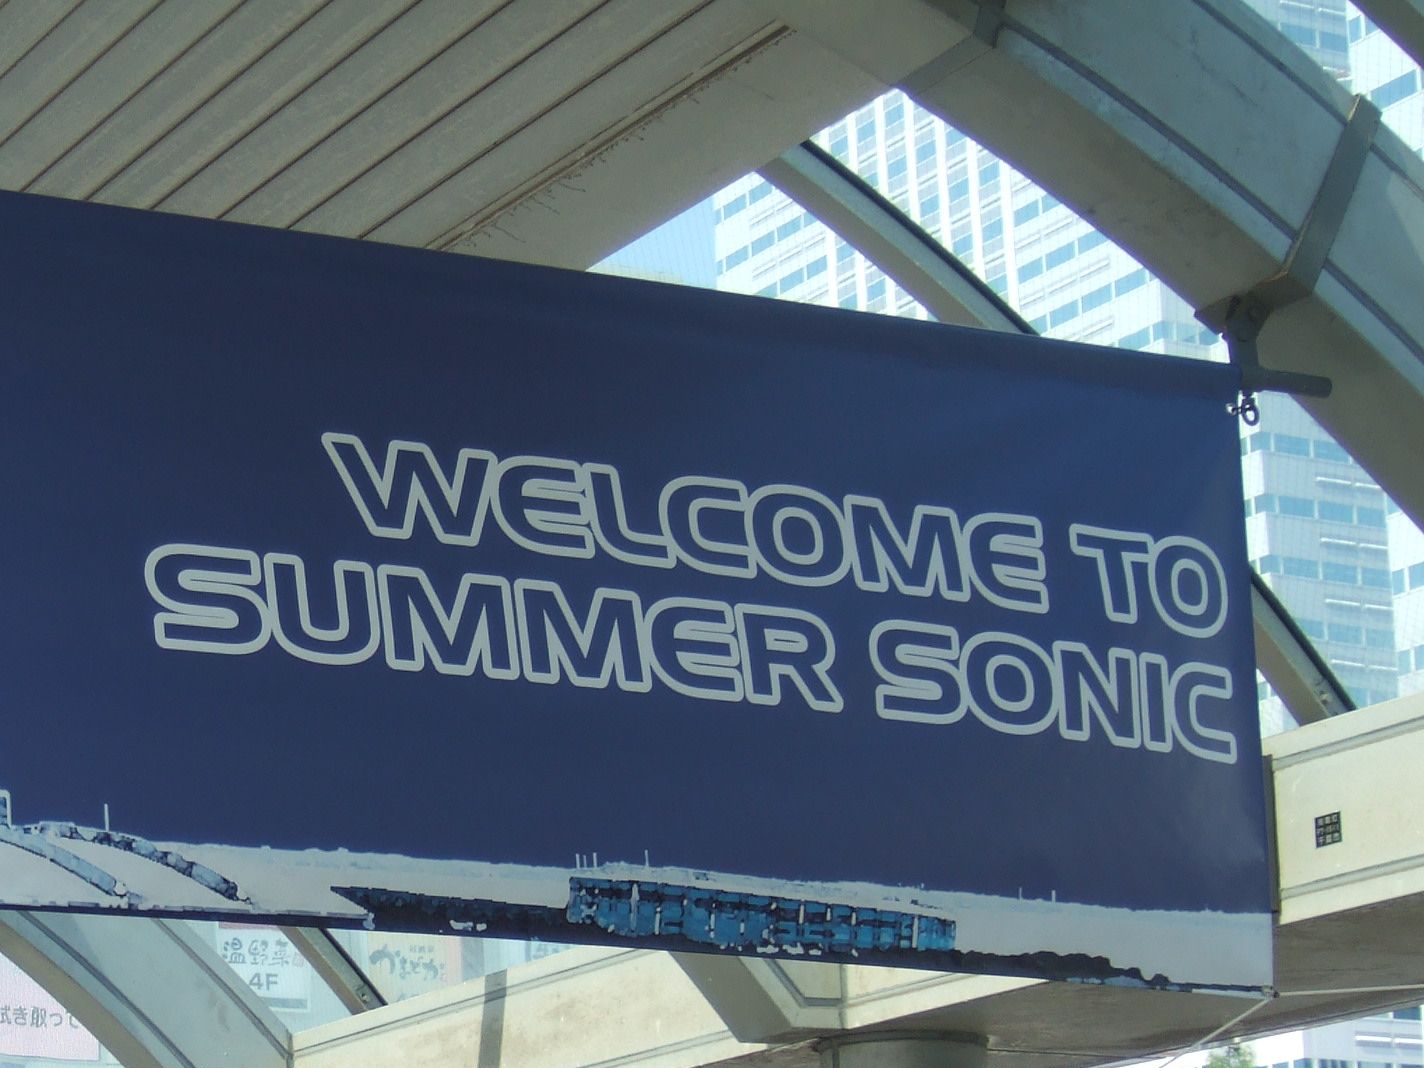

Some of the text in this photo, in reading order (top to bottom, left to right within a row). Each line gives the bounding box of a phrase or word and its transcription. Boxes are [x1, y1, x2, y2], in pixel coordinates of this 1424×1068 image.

[321, 431, 1229, 639] WELCOME TO
[143, 543, 1237, 764] SUMMER SONIC
[248, 973, 278, 991] 4F
